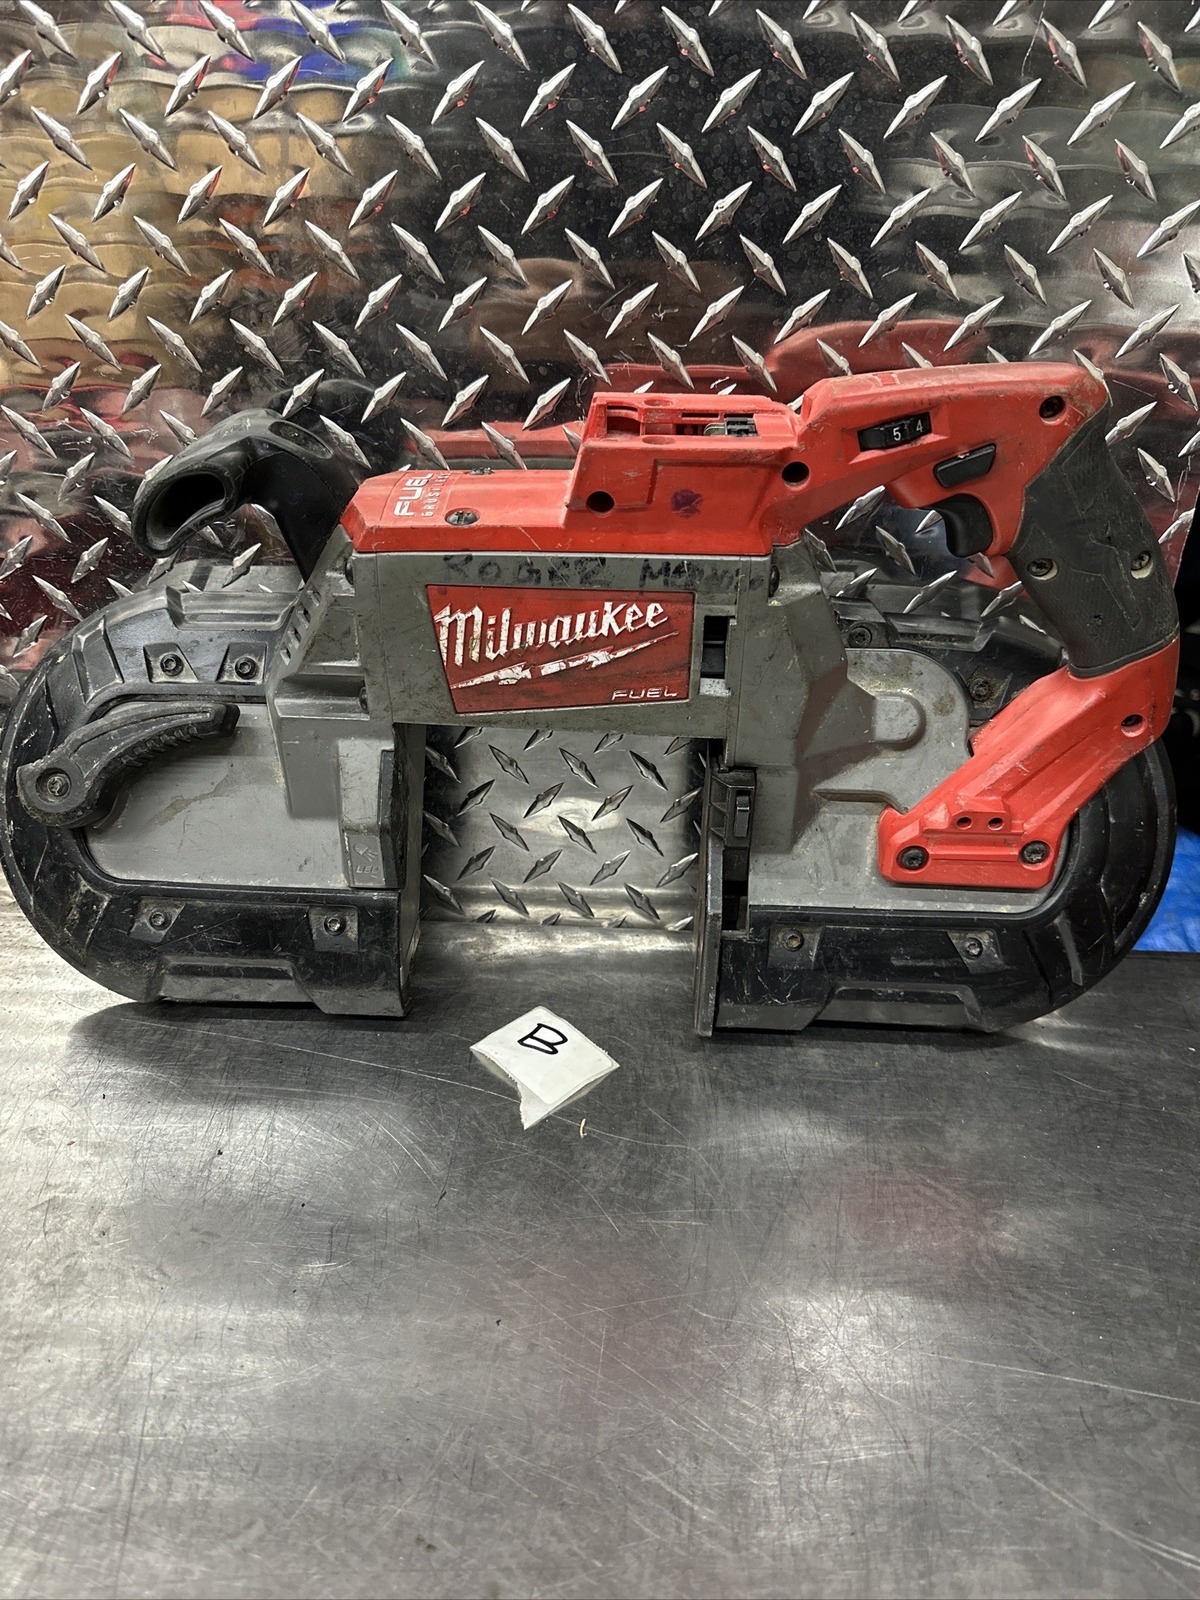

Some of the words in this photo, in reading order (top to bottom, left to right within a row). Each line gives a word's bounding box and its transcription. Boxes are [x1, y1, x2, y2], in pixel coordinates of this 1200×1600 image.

[893, 427, 902, 441] 5
[915, 419, 924, 433] 4
[393, 473, 434, 516] FUEL
[434, 601, 669, 668] Milwaukee
[611, 686, 678, 701] FUEL
[355, 865, 381, 874] LED
[517, 1022, 569, 1055] B
